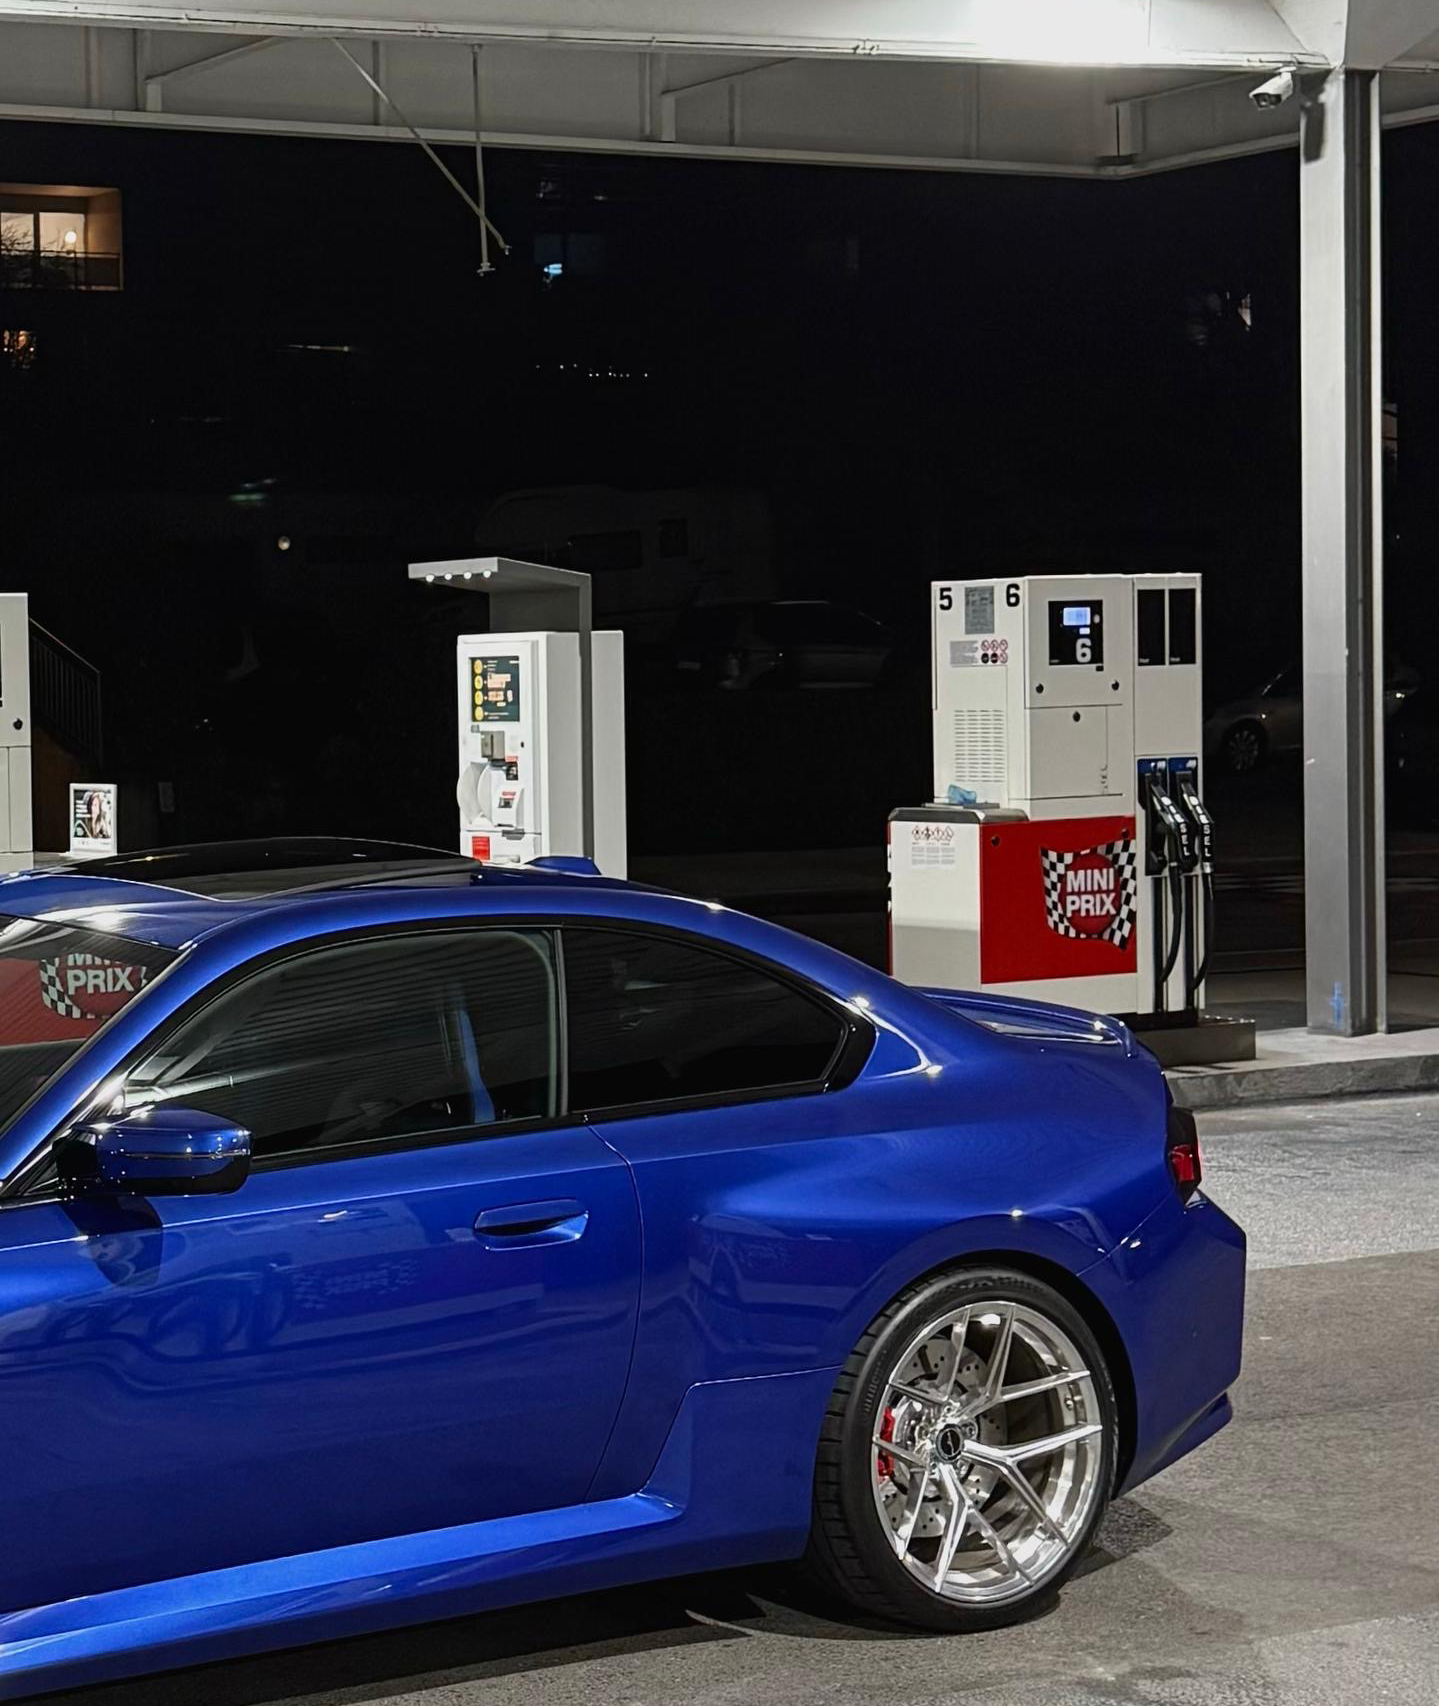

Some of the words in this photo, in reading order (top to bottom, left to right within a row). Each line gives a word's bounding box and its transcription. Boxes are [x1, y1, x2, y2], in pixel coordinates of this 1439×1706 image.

[939, 587, 953, 611] 5
[1006, 583, 1020, 607] 6
[1075, 638, 1092, 663] 6
[1066, 868, 1114, 893] MINI
[1066, 892, 1117, 918] PRIX
[66, 966, 135, 996] PRIX
